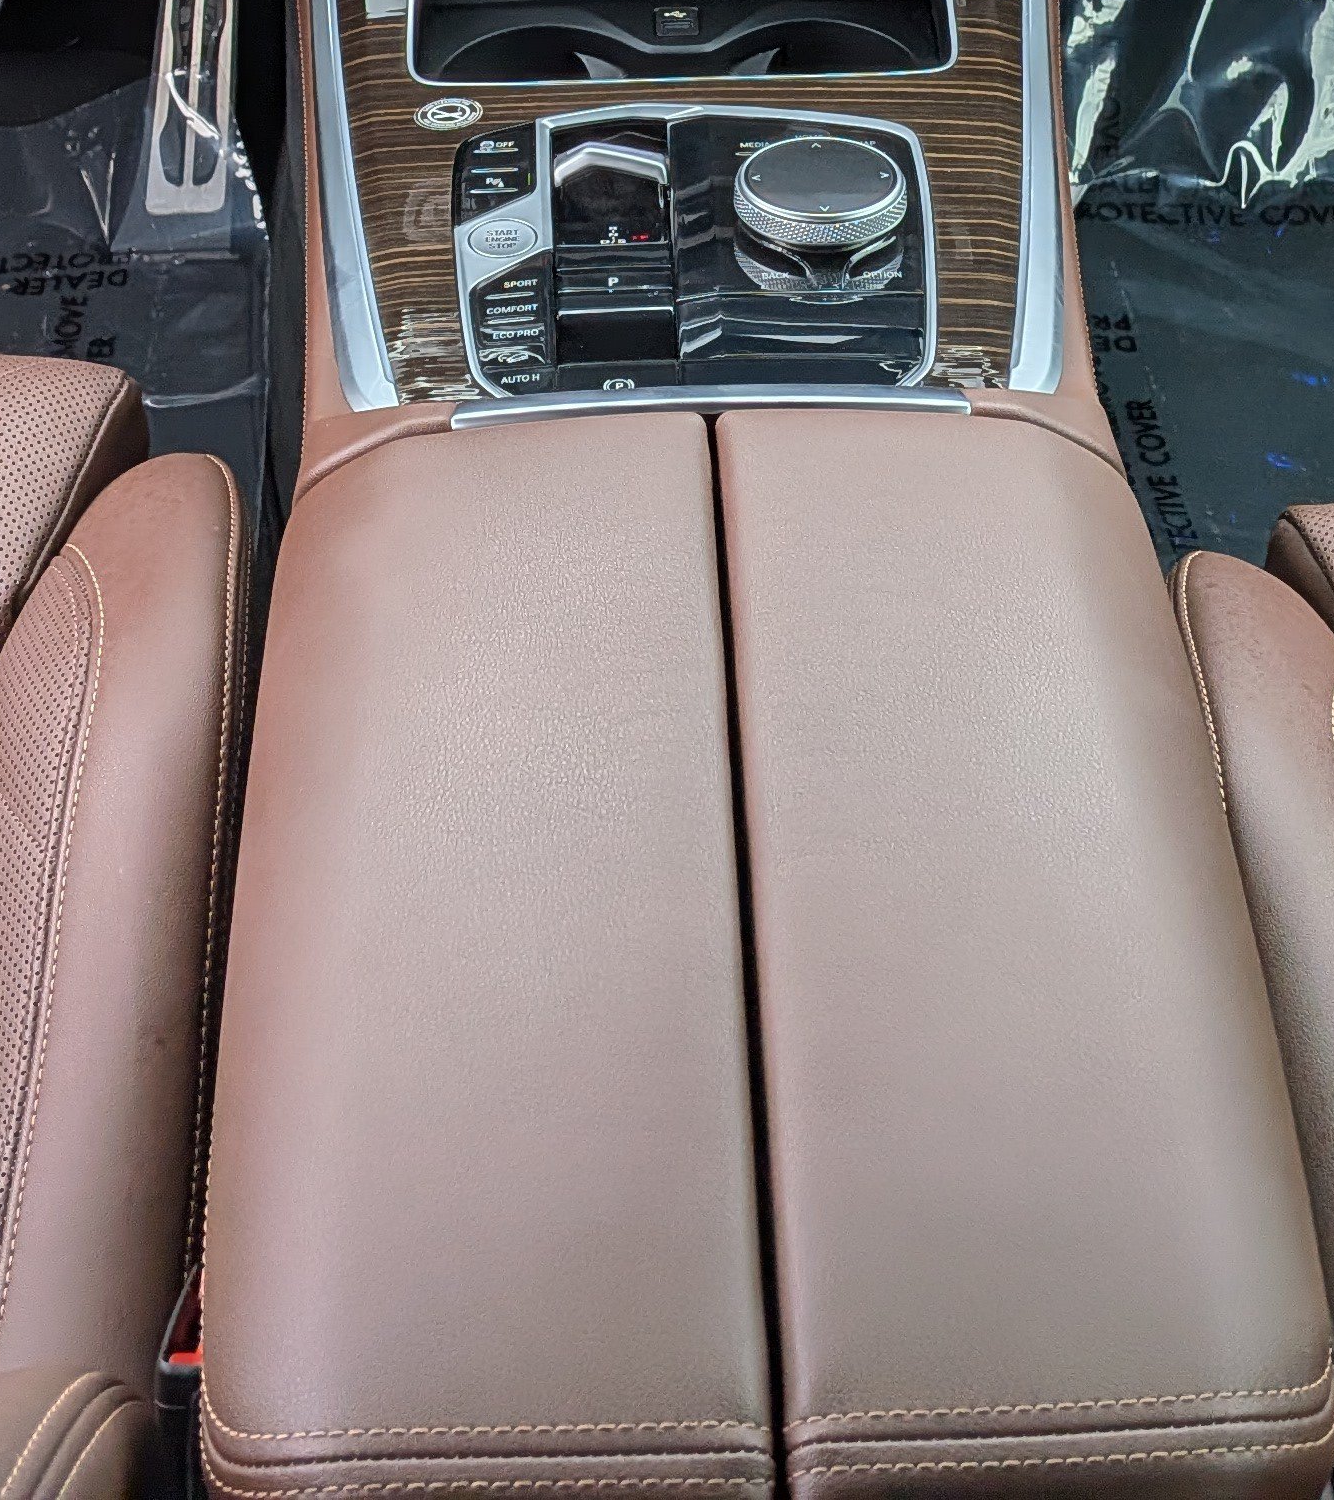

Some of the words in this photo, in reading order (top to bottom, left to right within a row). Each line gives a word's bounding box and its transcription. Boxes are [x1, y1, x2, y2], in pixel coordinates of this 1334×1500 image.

[13, 269, 128, 297] DEALER
[503, 279, 538, 289] SPORT
[486, 303, 539, 315] COMFORT
[492, 330, 515, 340] ECO
[517, 328, 539, 338] PRO
[500, 374, 530, 384] AUTO
[531, 373, 540, 381] H
[1125, 399, 1171, 466] COVER
